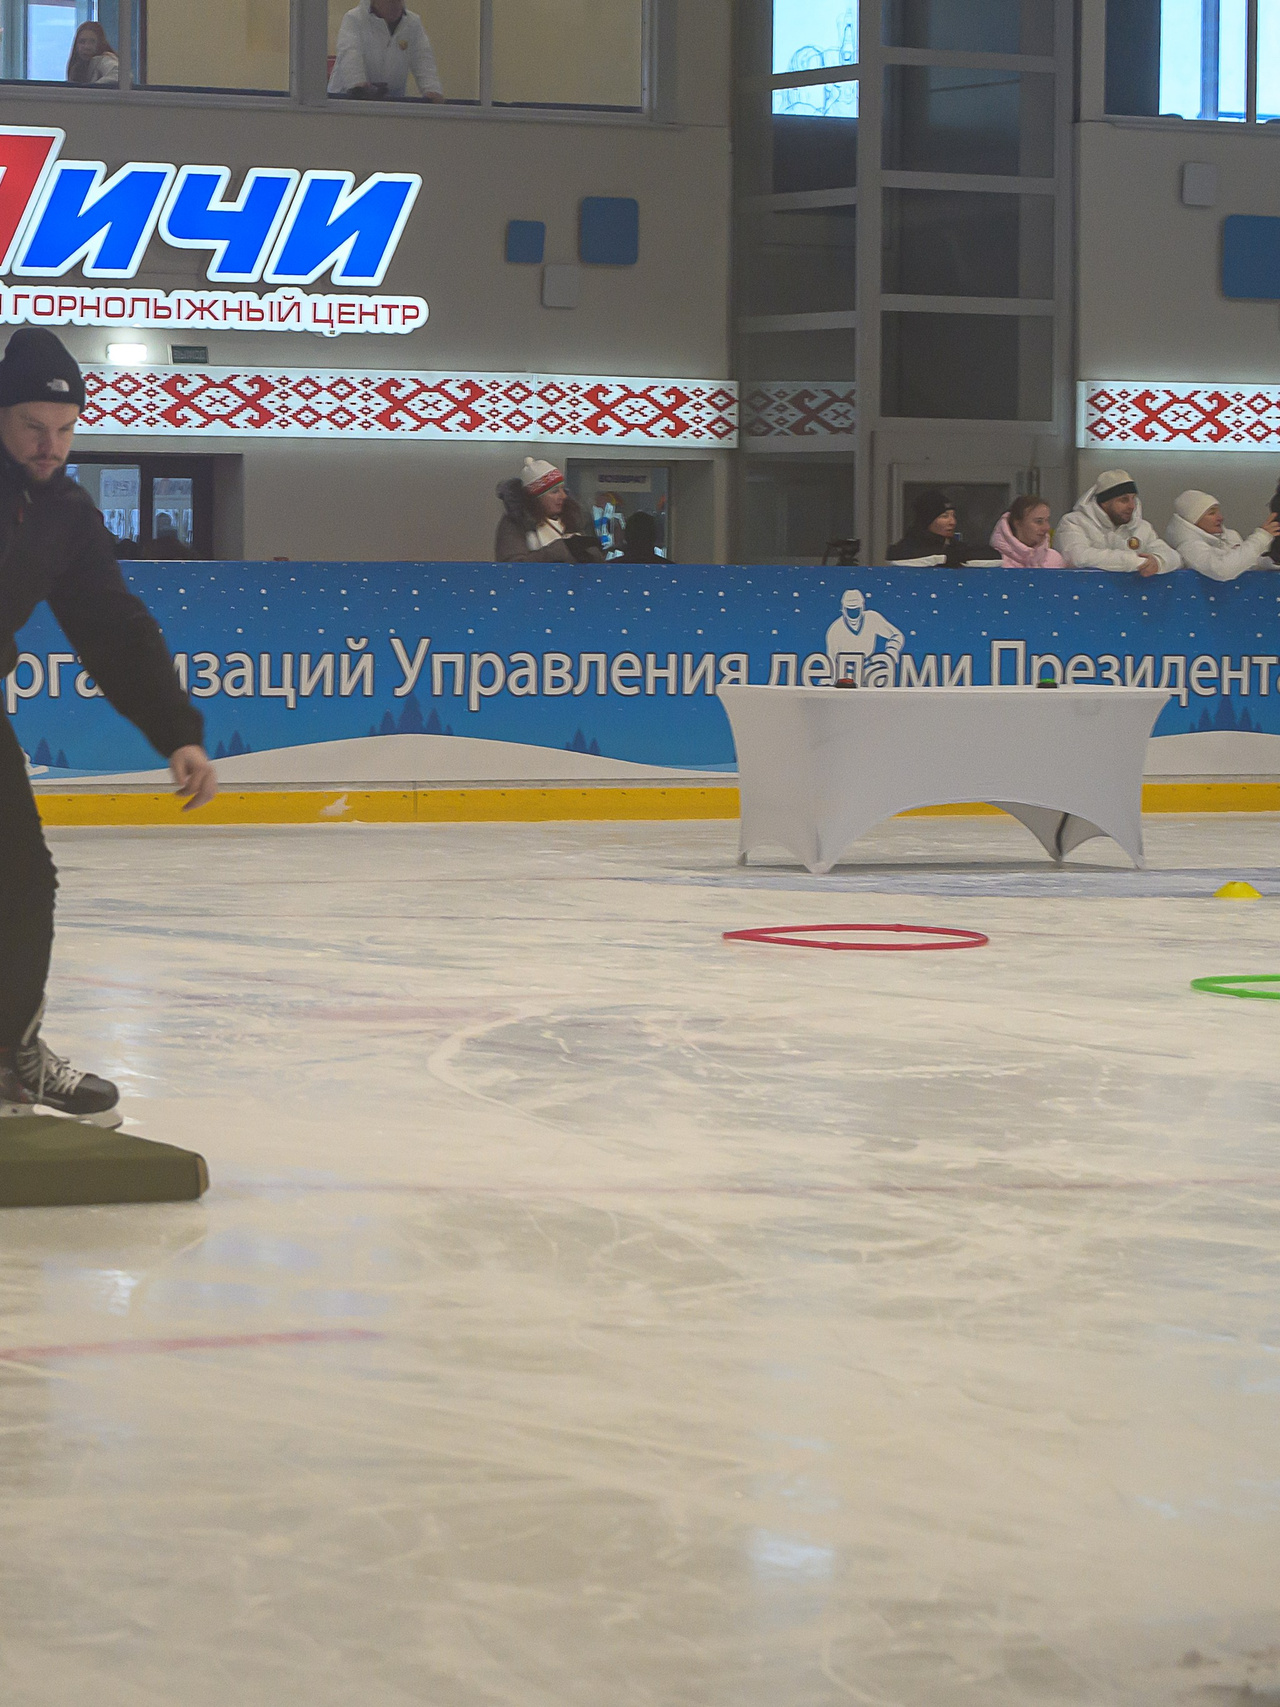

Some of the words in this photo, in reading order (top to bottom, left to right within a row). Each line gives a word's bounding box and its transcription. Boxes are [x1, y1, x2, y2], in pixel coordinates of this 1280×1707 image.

[12, 293, 303, 324] ГОРНОЛЫЖНЫЙ
[311, 301, 421, 330] ЦЕНТР
[390, 637, 750, 712] Управления
